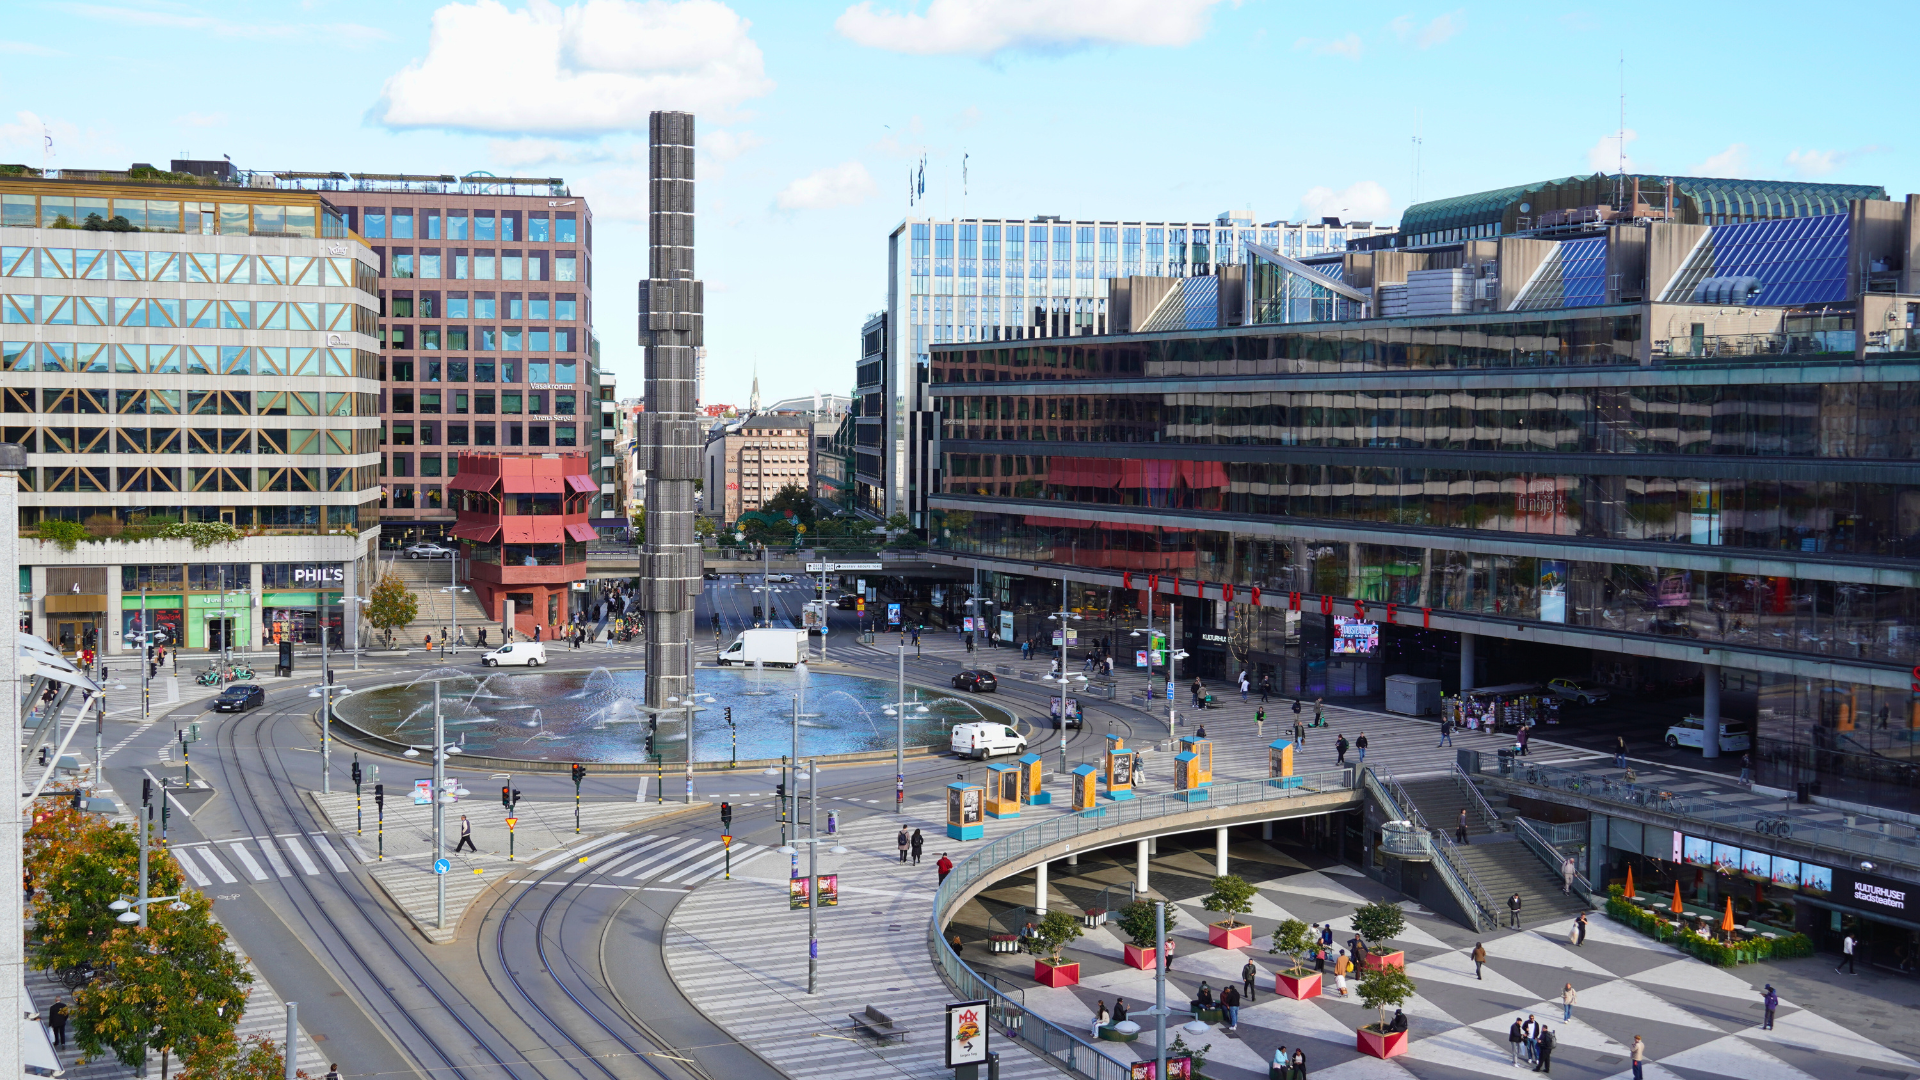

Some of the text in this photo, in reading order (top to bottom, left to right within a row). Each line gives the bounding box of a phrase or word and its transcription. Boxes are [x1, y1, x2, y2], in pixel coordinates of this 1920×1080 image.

[530, 382, 573, 390] Vasakronan
[294, 568, 344, 582] PHIL'S
[72, 582, 80, 594] 4
[1124, 571, 1432, 629] KULTURHUSET
[1854, 881, 1905, 901] KULTURHUSET
[1854, 891, 1905, 909] stadsteatern
[958, 1009, 979, 1024] MAX
